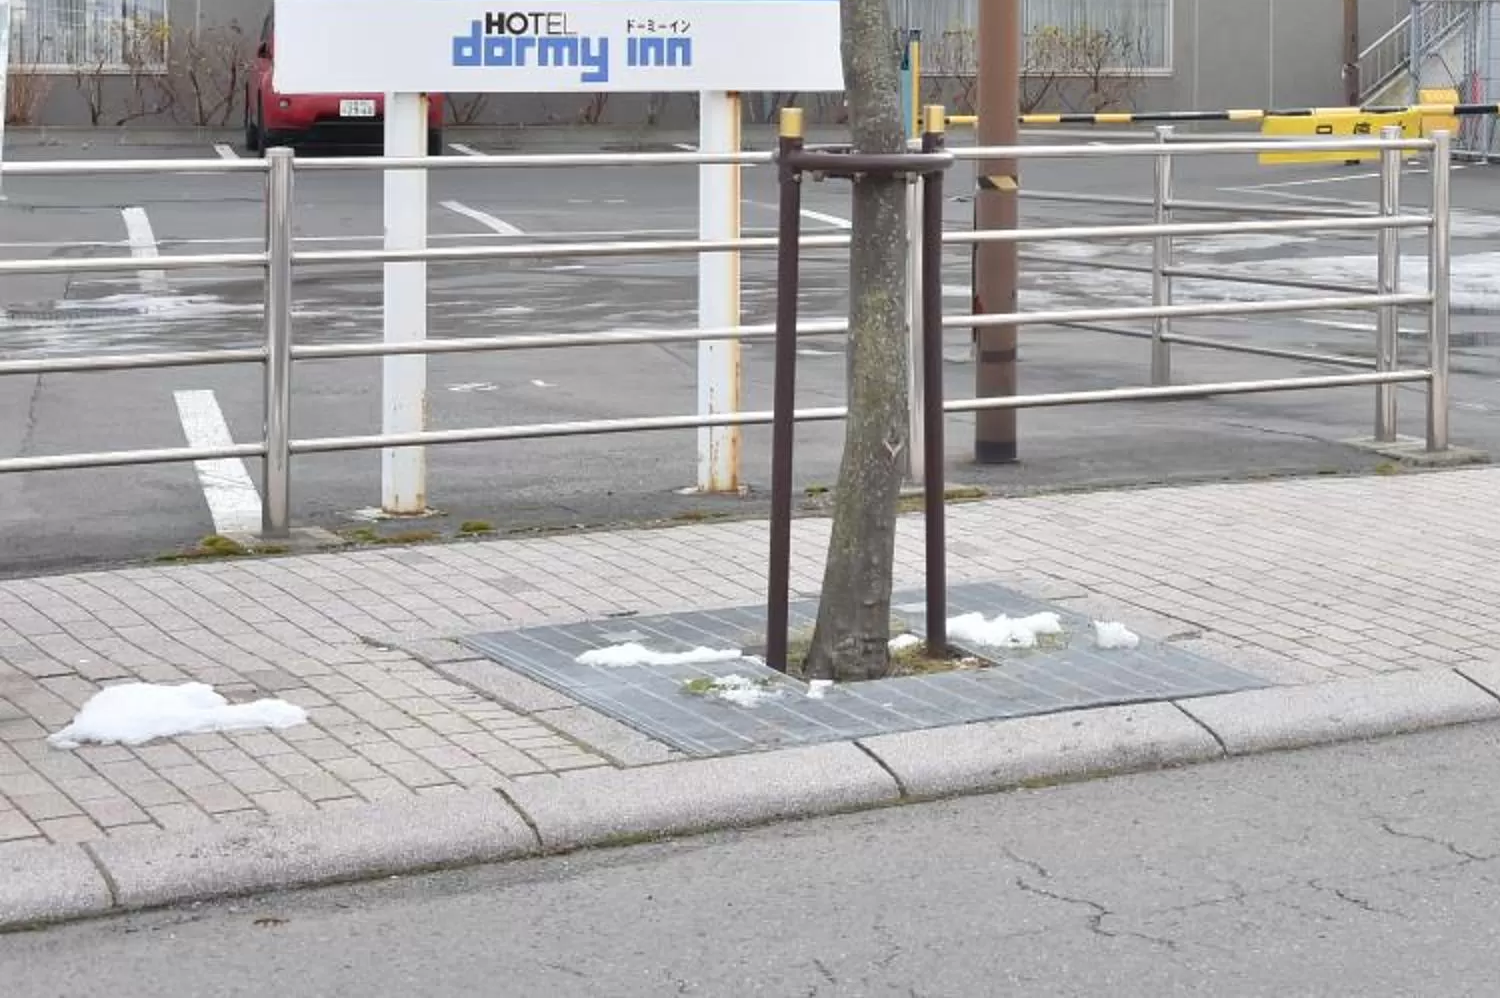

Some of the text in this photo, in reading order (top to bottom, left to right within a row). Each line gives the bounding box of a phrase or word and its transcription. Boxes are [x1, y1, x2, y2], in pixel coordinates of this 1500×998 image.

[485, 12, 578, 35] HOTEL
[627, 19, 691, 33] ドーミーイン
[453, 20, 691, 82] dormy inn
